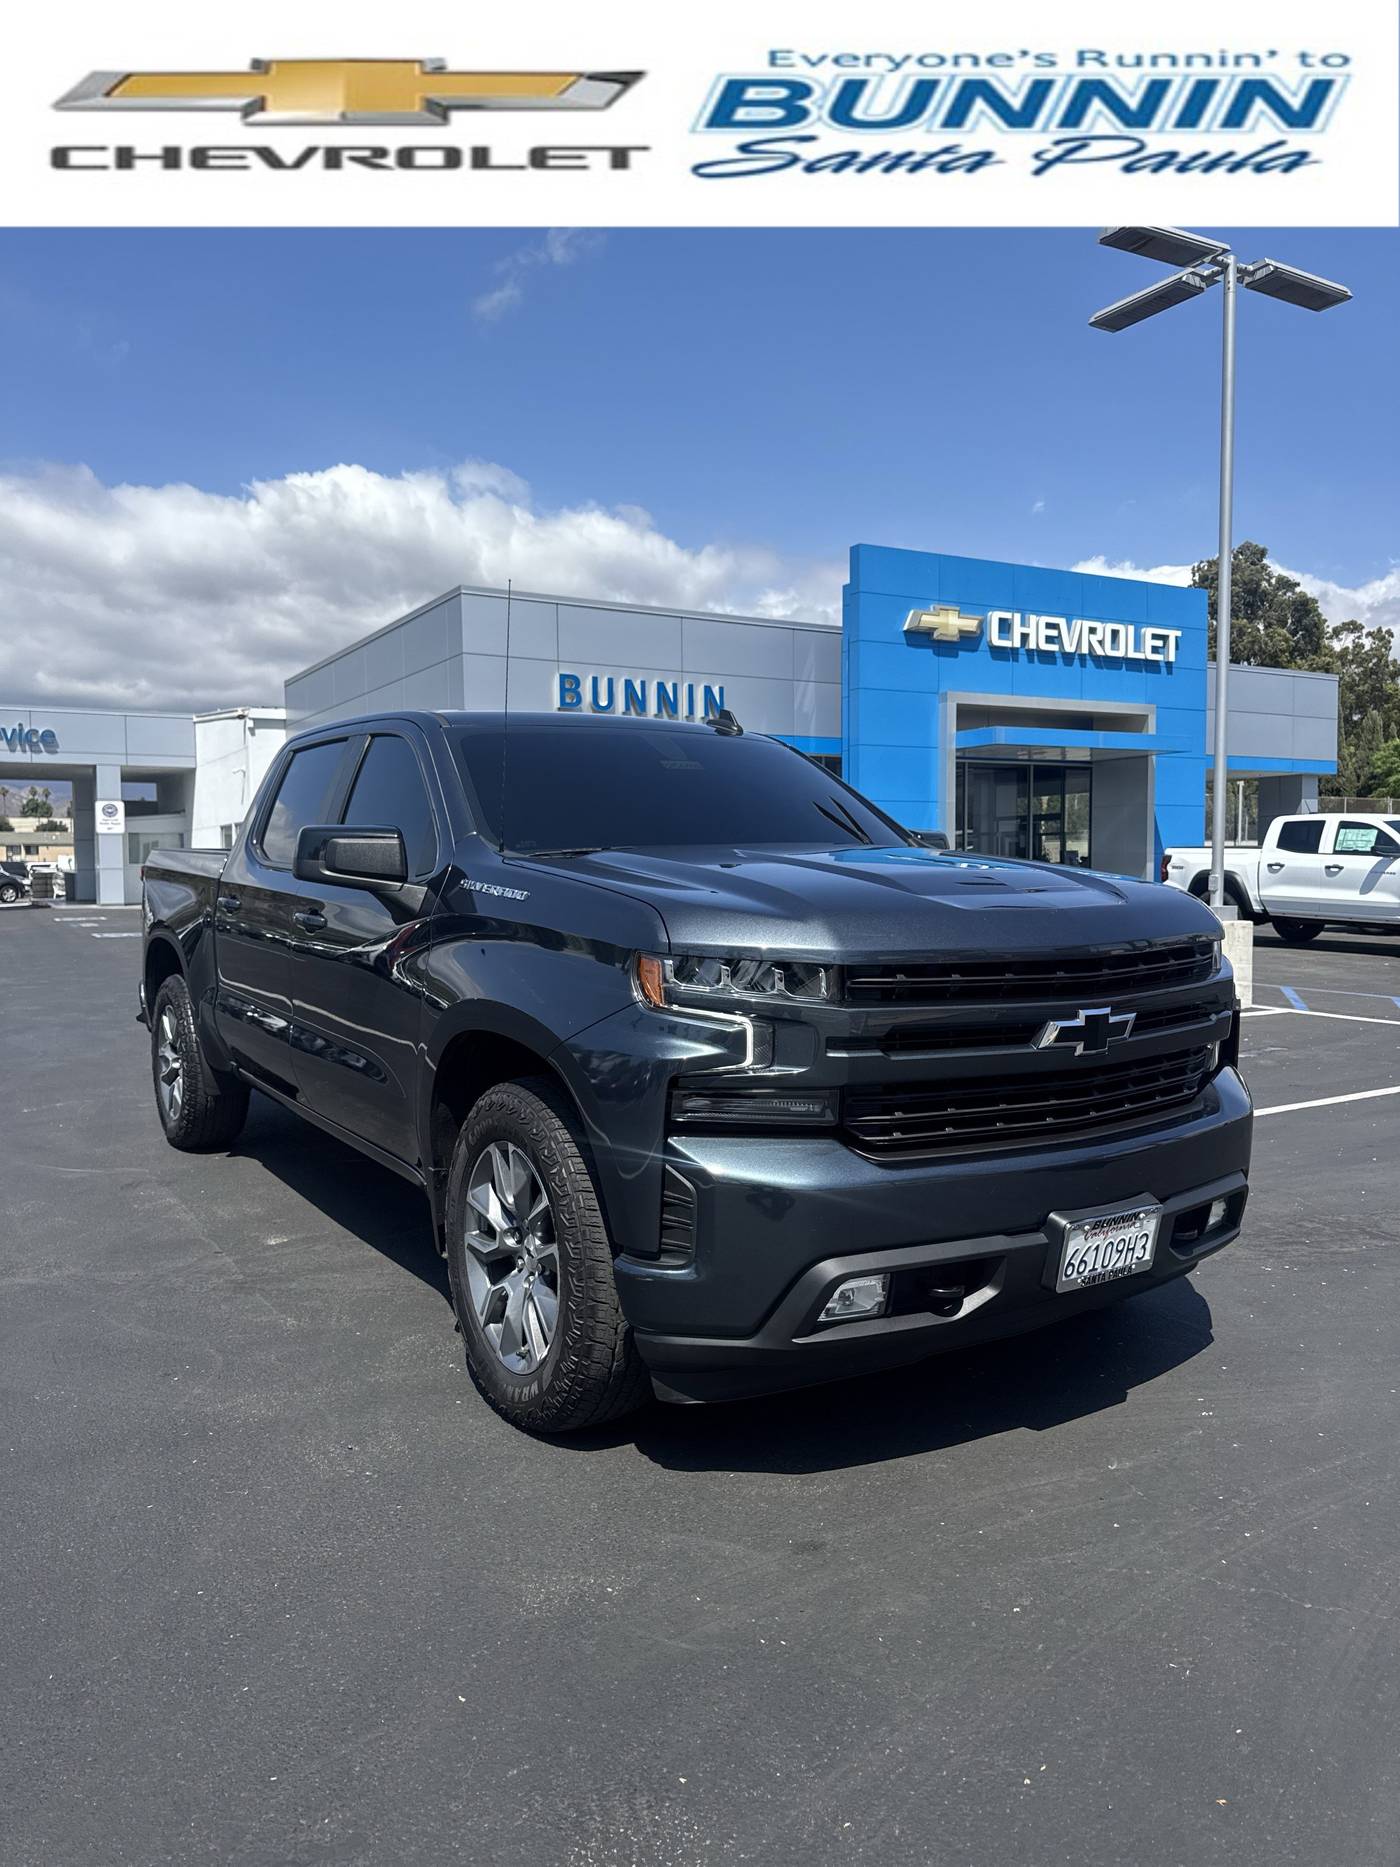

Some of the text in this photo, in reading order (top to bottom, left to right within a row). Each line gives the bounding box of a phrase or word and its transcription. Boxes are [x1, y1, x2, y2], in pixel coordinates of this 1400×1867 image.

[988, 610, 1182, 662] CHEVROLET
[557, 673, 725, 718] BUNNIN
[0, 722, 57, 752] vice
[1084, 1220, 1142, 1241] California
[1091, 1212, 1140, 1230] BUNNIN
[1063, 1232, 1150, 1278] 66109H3
[1080, 1264, 1133, 1286] SANTA PAULA
